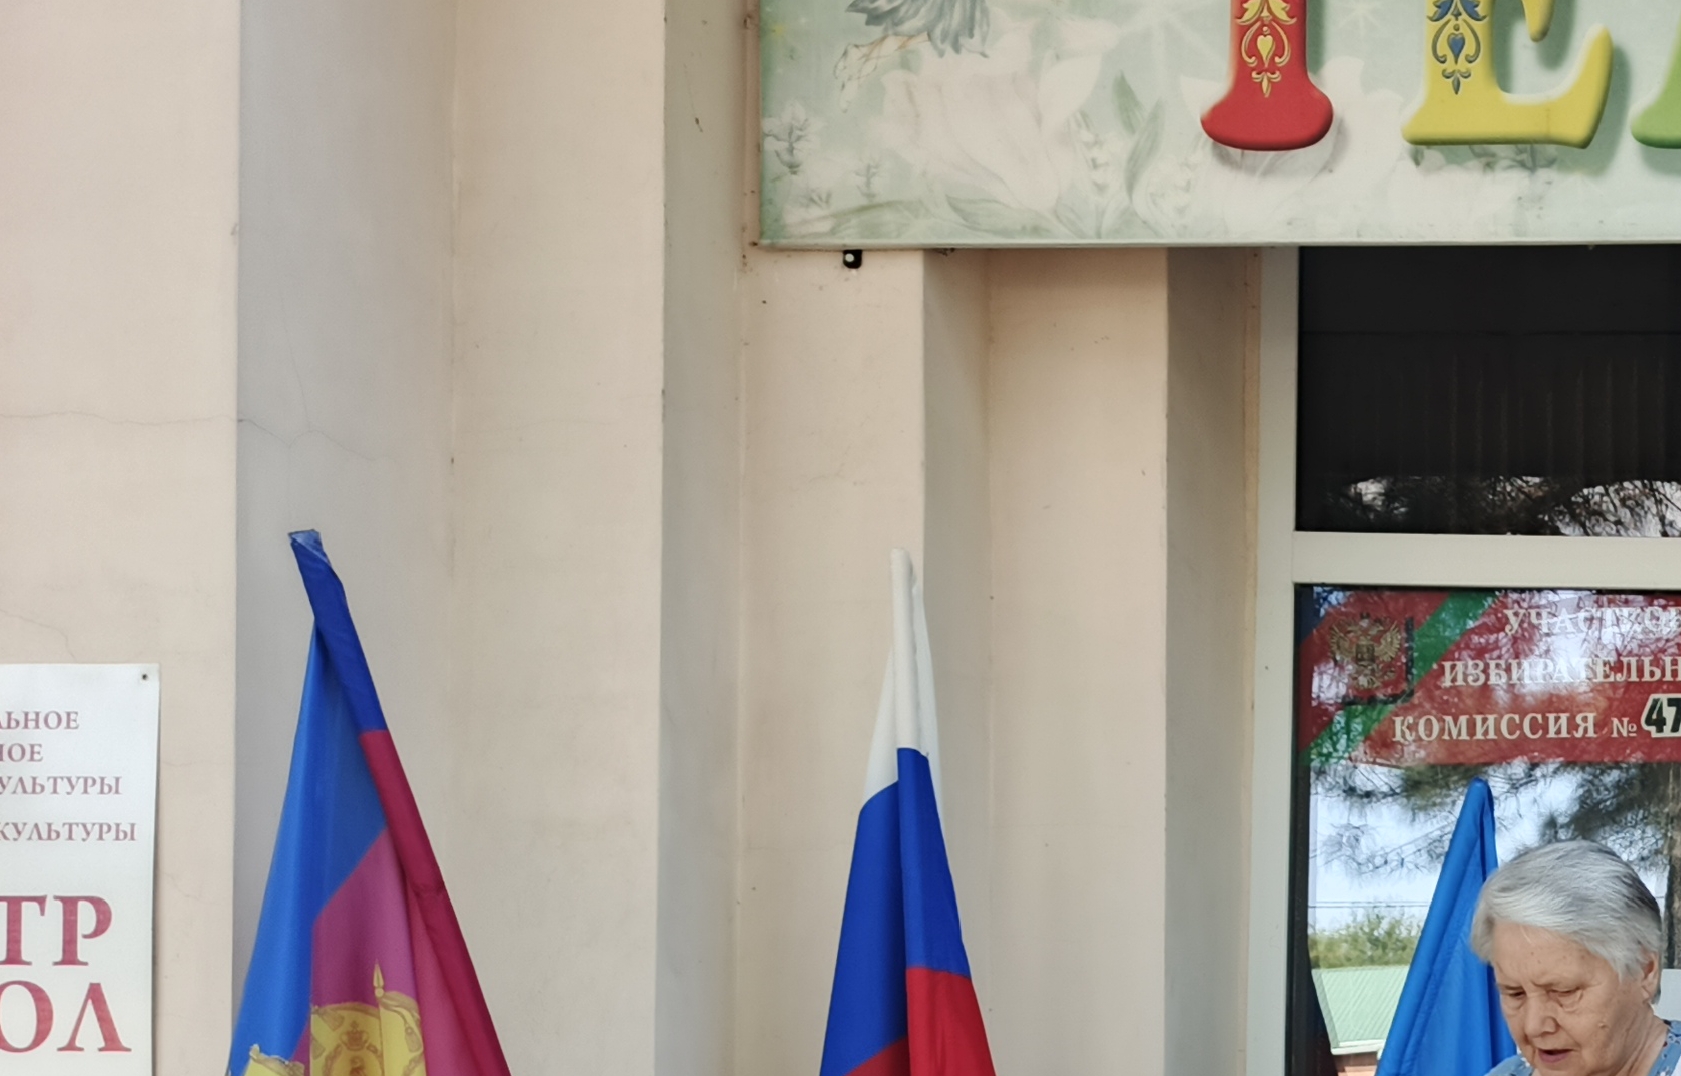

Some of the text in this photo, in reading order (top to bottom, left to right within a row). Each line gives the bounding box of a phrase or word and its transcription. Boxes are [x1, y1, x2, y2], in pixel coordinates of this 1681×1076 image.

[1391, 712, 1597, 742] КОМИССИЯ
[1611, 717, 1637, 738] №
[0, 894, 112, 966] ТР
[0, 980, 132, 1052] ОЛ
